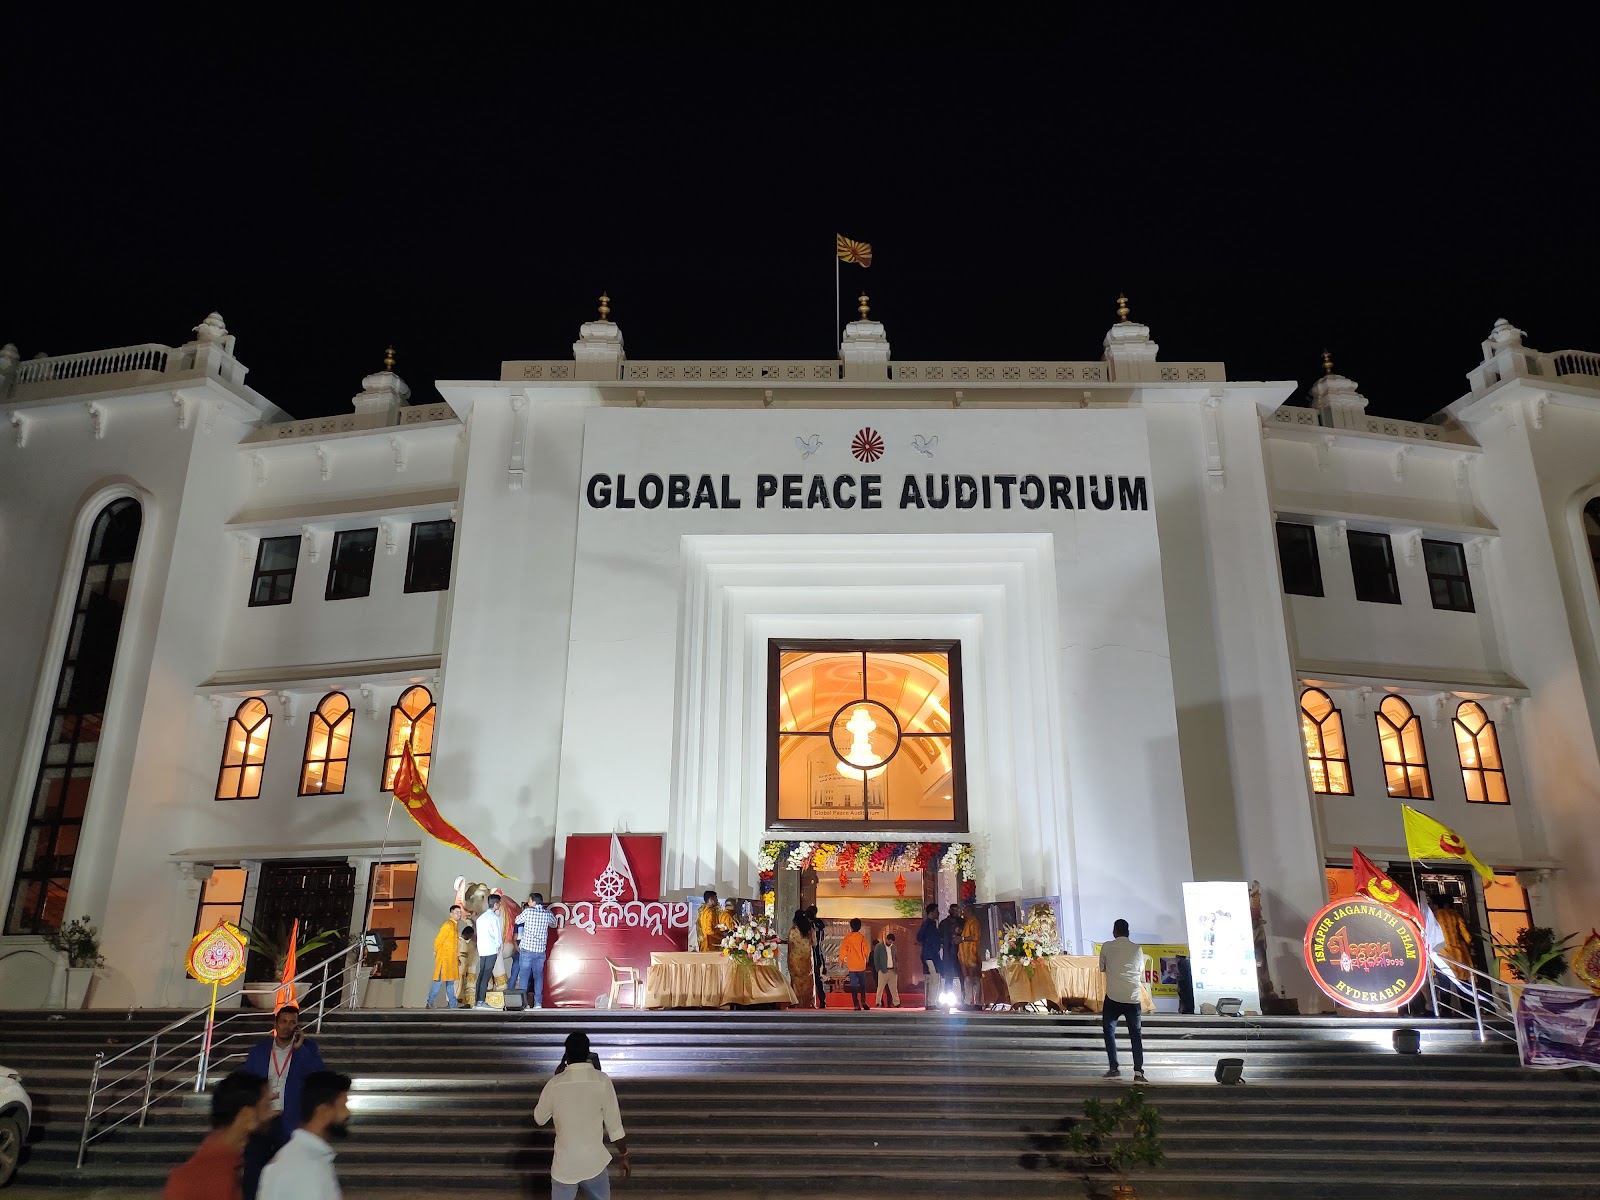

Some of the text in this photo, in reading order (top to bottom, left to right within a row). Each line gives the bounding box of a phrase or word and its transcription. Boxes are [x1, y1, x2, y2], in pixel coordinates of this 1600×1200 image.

[586, 473, 1148, 511] GLOBAL PEACE AUDITORIUM
[599, 901, 693, 936] ଜଗନ୍ନାଥ
[1314, 905, 1417, 963] ISNAPUR JAGANNATH DHAM
[1335, 978, 1407, 1002] HYDERABAD
